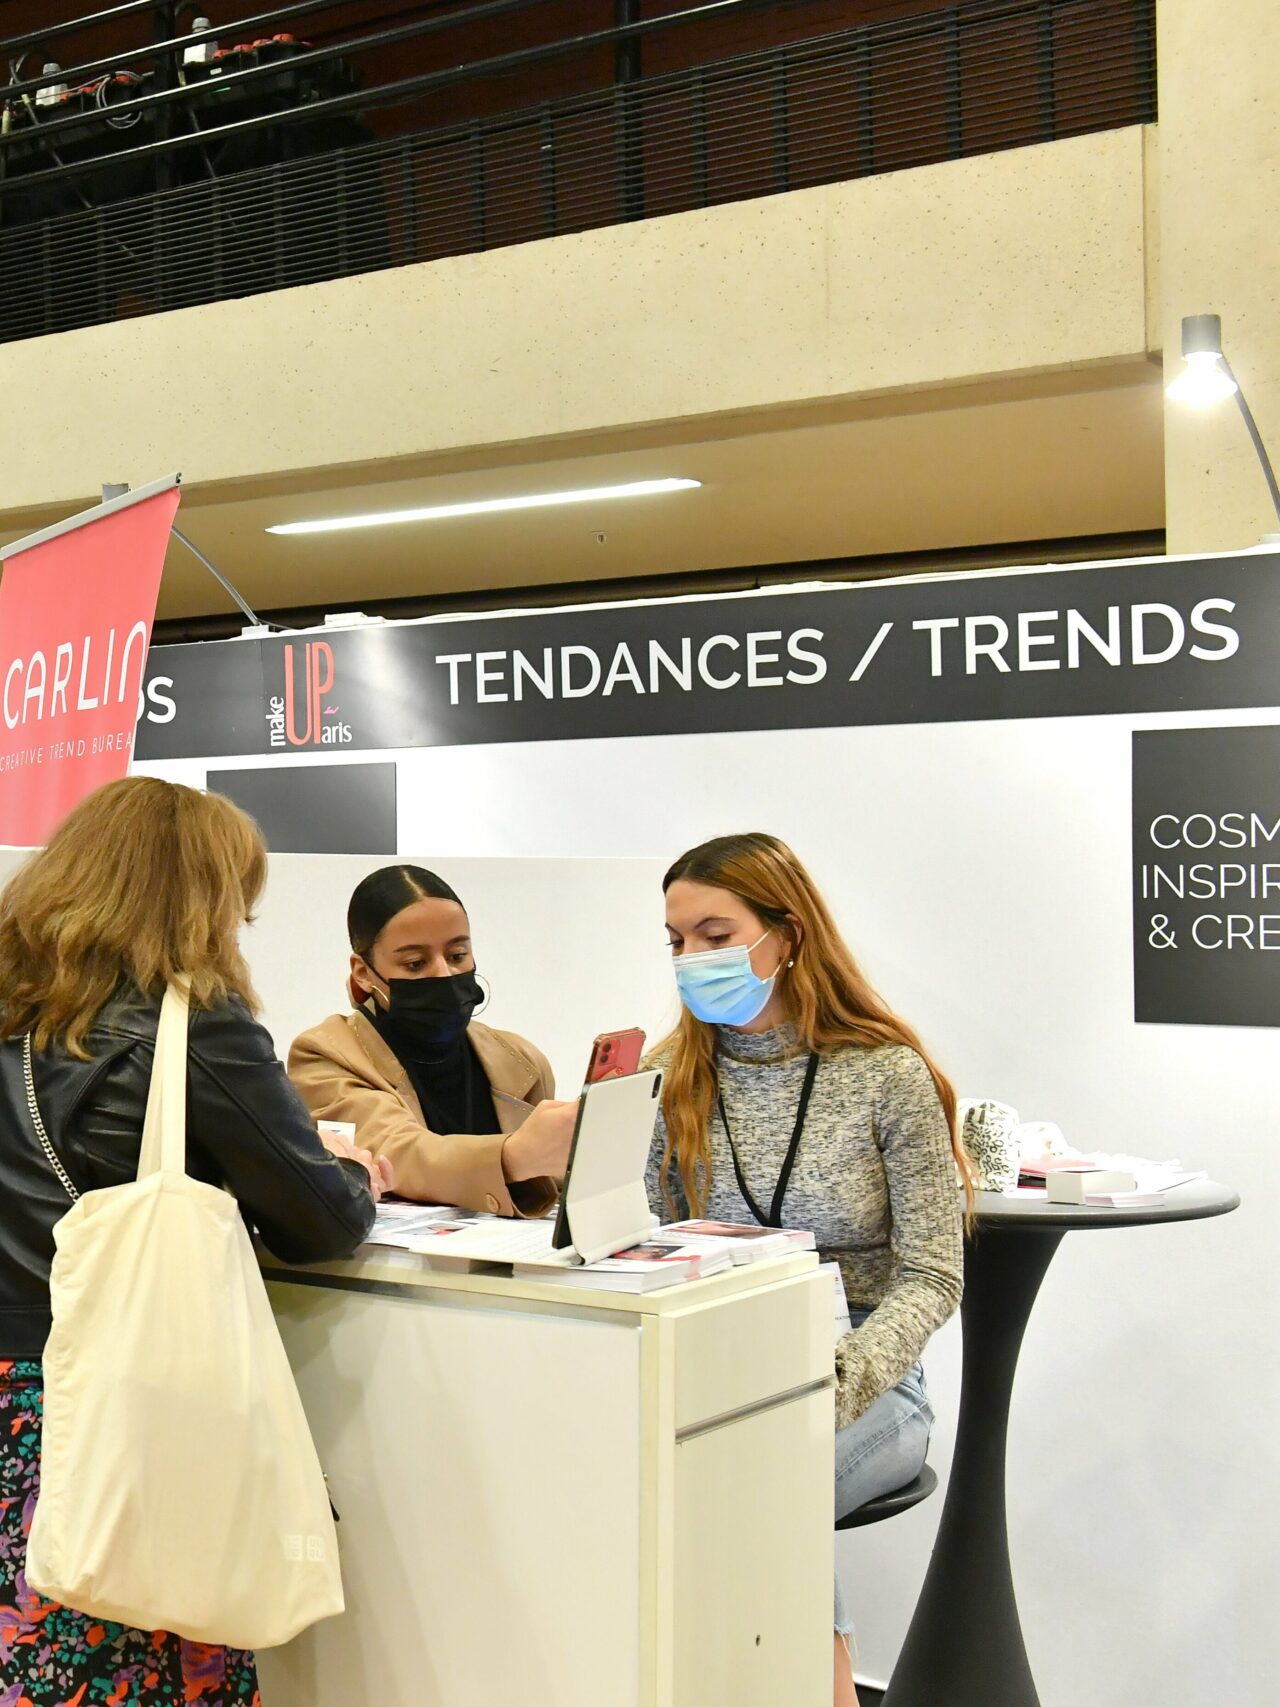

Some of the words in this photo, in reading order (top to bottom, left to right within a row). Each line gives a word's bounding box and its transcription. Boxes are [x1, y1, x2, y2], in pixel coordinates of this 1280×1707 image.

[435, 628, 827, 705] TENDANCES
[849, 622, 894, 682] /
[912, 598, 1241, 677] TRENDS
[284, 641, 335, 745] UP
[265, 696, 286, 747] make
[0, 747, 44, 772] CREATIVE
[50, 739, 86, 761] TREND
[1150, 812, 1280, 849] COSM
[1143, 863, 1280, 899] INSPIR
[1148, 913, 1179, 949] &
[1192, 914, 1280, 950] CRE
